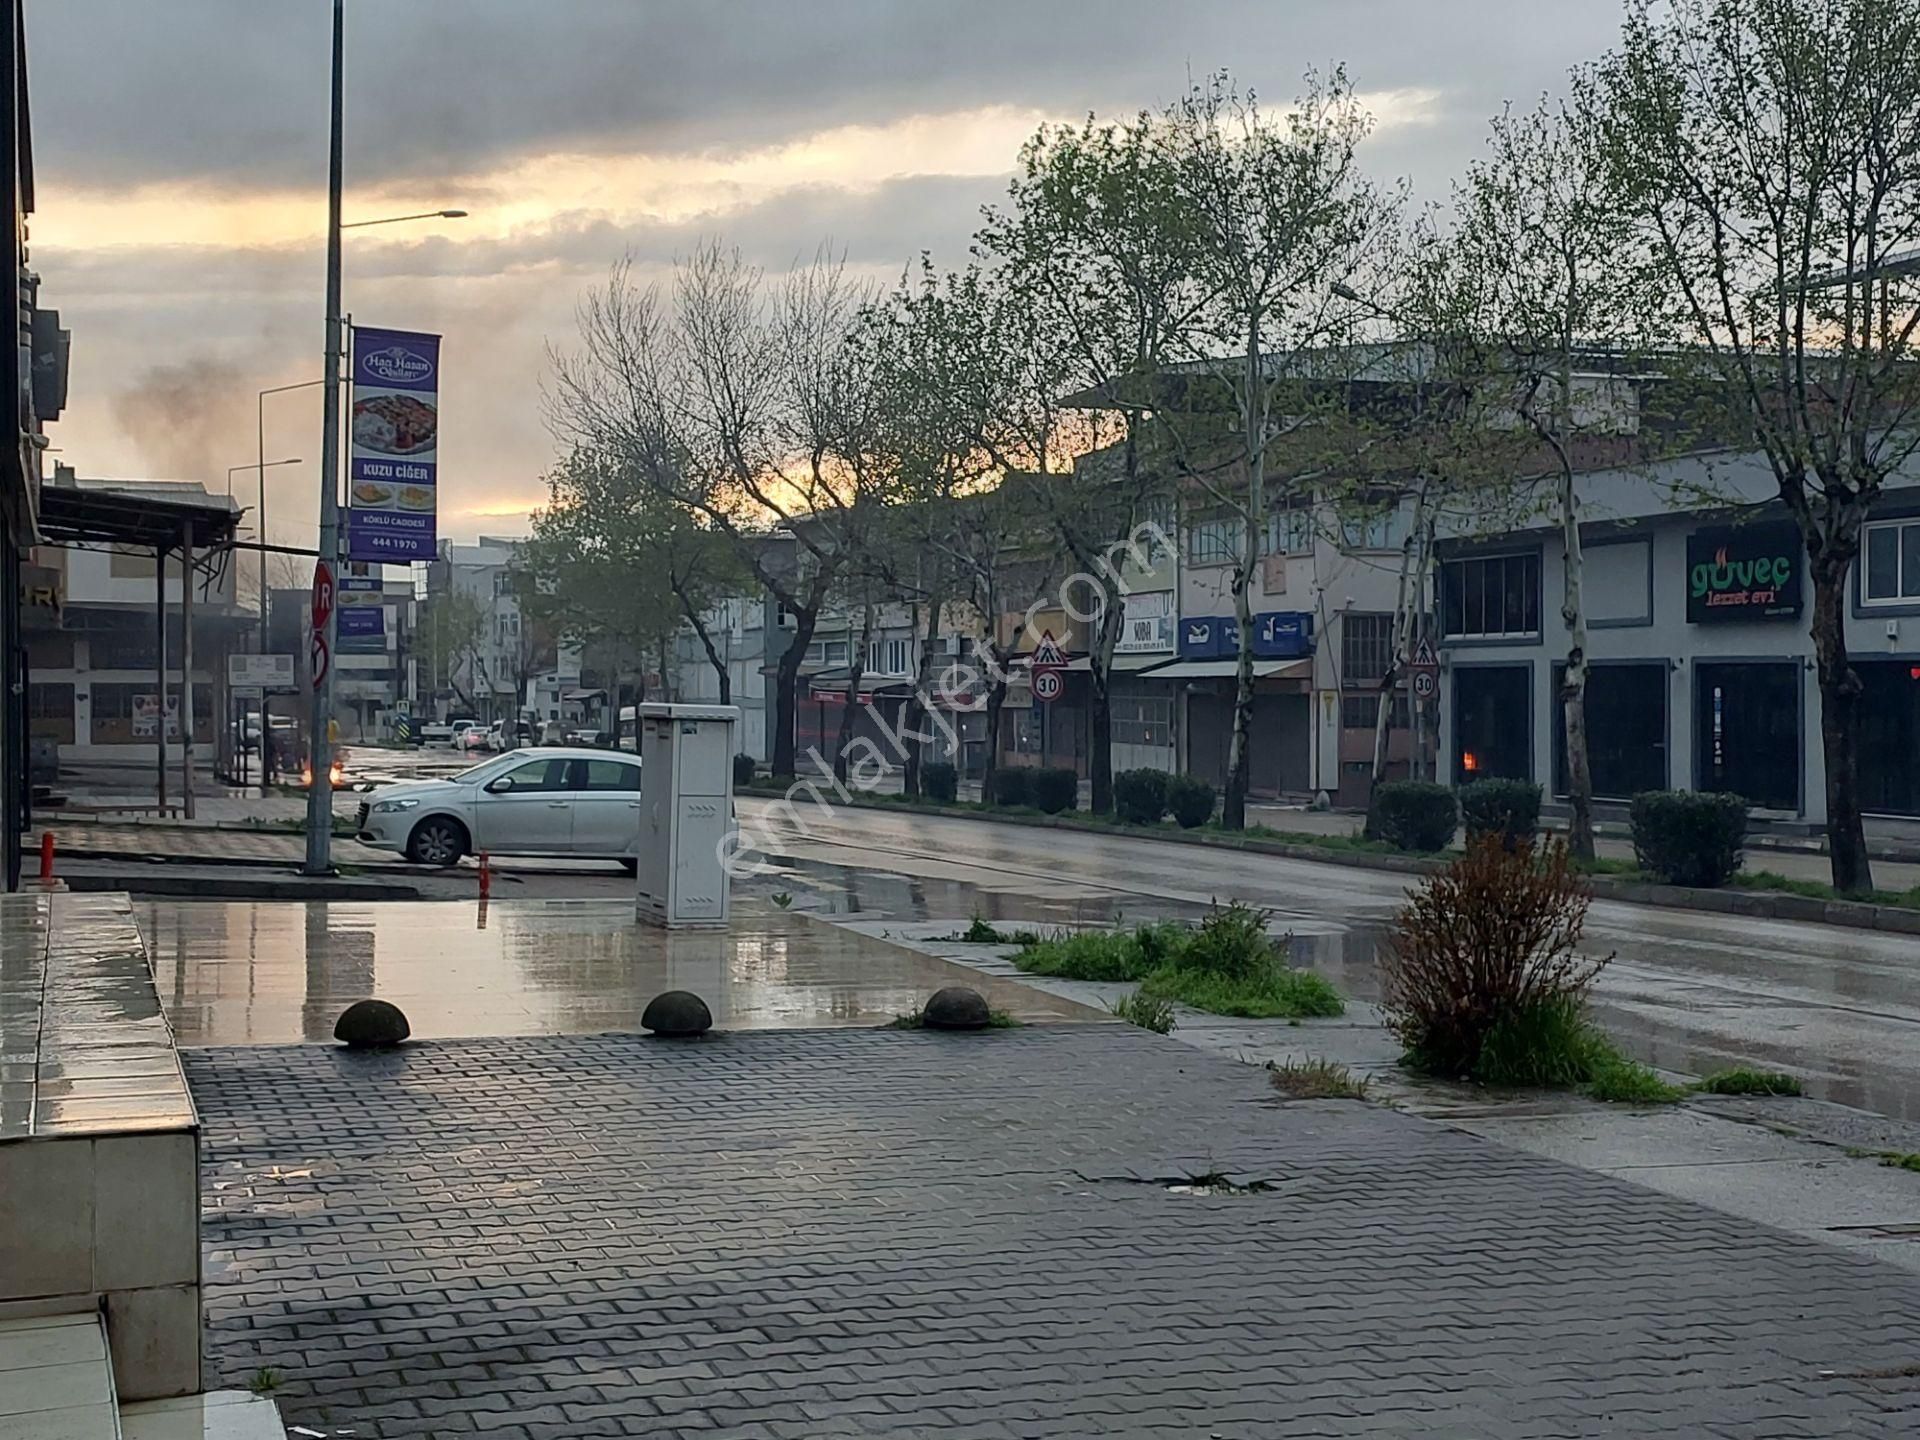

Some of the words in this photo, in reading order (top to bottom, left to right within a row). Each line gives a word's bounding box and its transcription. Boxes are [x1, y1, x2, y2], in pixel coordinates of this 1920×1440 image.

[363, 463, 393, 476] KUZU
[395, 464, 428, 480] CİĞER
[363, 515, 390, 525] KÖKLÜ
[391, 517, 426, 528] CADDESİ
[372, 538, 391, 547] 444
[393, 539, 418, 550] 1970
[1752, 585, 1776, 604] evi
[1039, 678, 1056, 692] 30
[1417, 678, 1431, 691] 30
